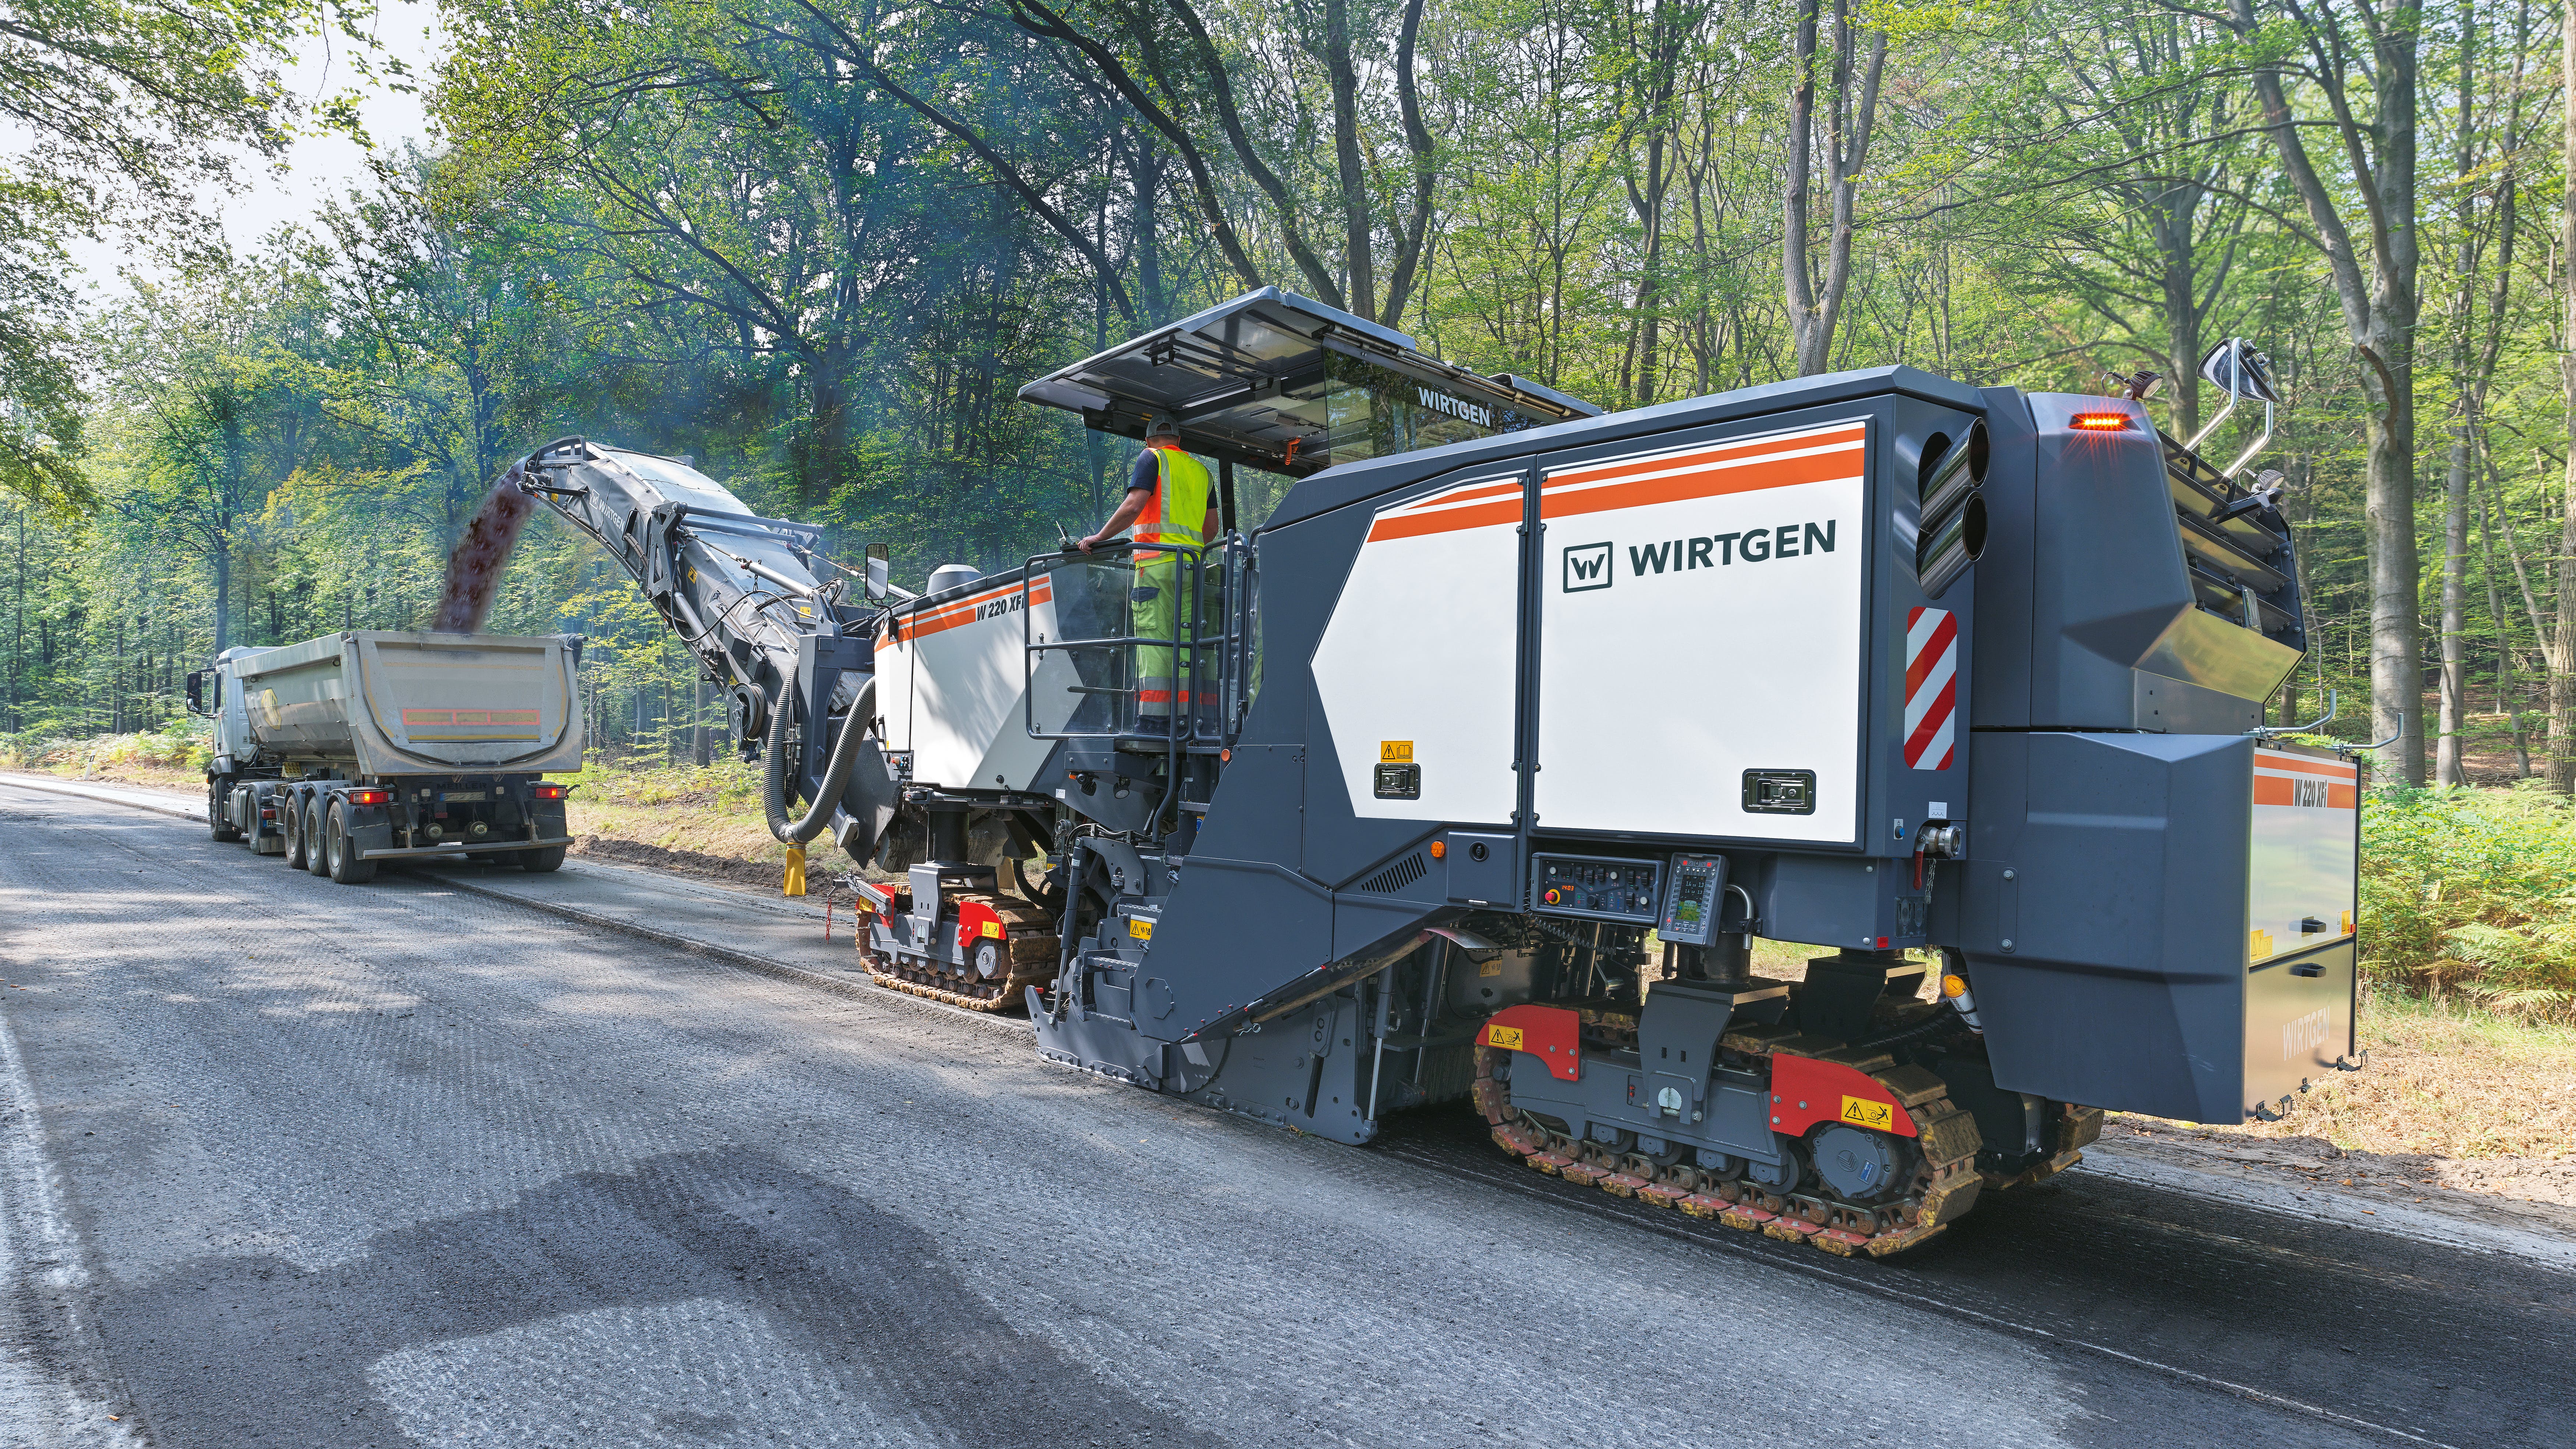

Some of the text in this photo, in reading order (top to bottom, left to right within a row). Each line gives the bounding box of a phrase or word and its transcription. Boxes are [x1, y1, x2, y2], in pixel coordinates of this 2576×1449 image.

[1418, 386, 1490, 427] WIRTGEN
[599, 499, 625, 531] WIRTGEN
[1628, 519, 1836, 577] WIRTGEN
[977, 605, 987, 621] W
[988, 599, 1007, 618] 220
[2295, 779, 2327, 808] W 220 XFi
[1952, 998, 1971, 1021] MARERFARBE
[2283, 1006, 2330, 1061] WIRTGEN
